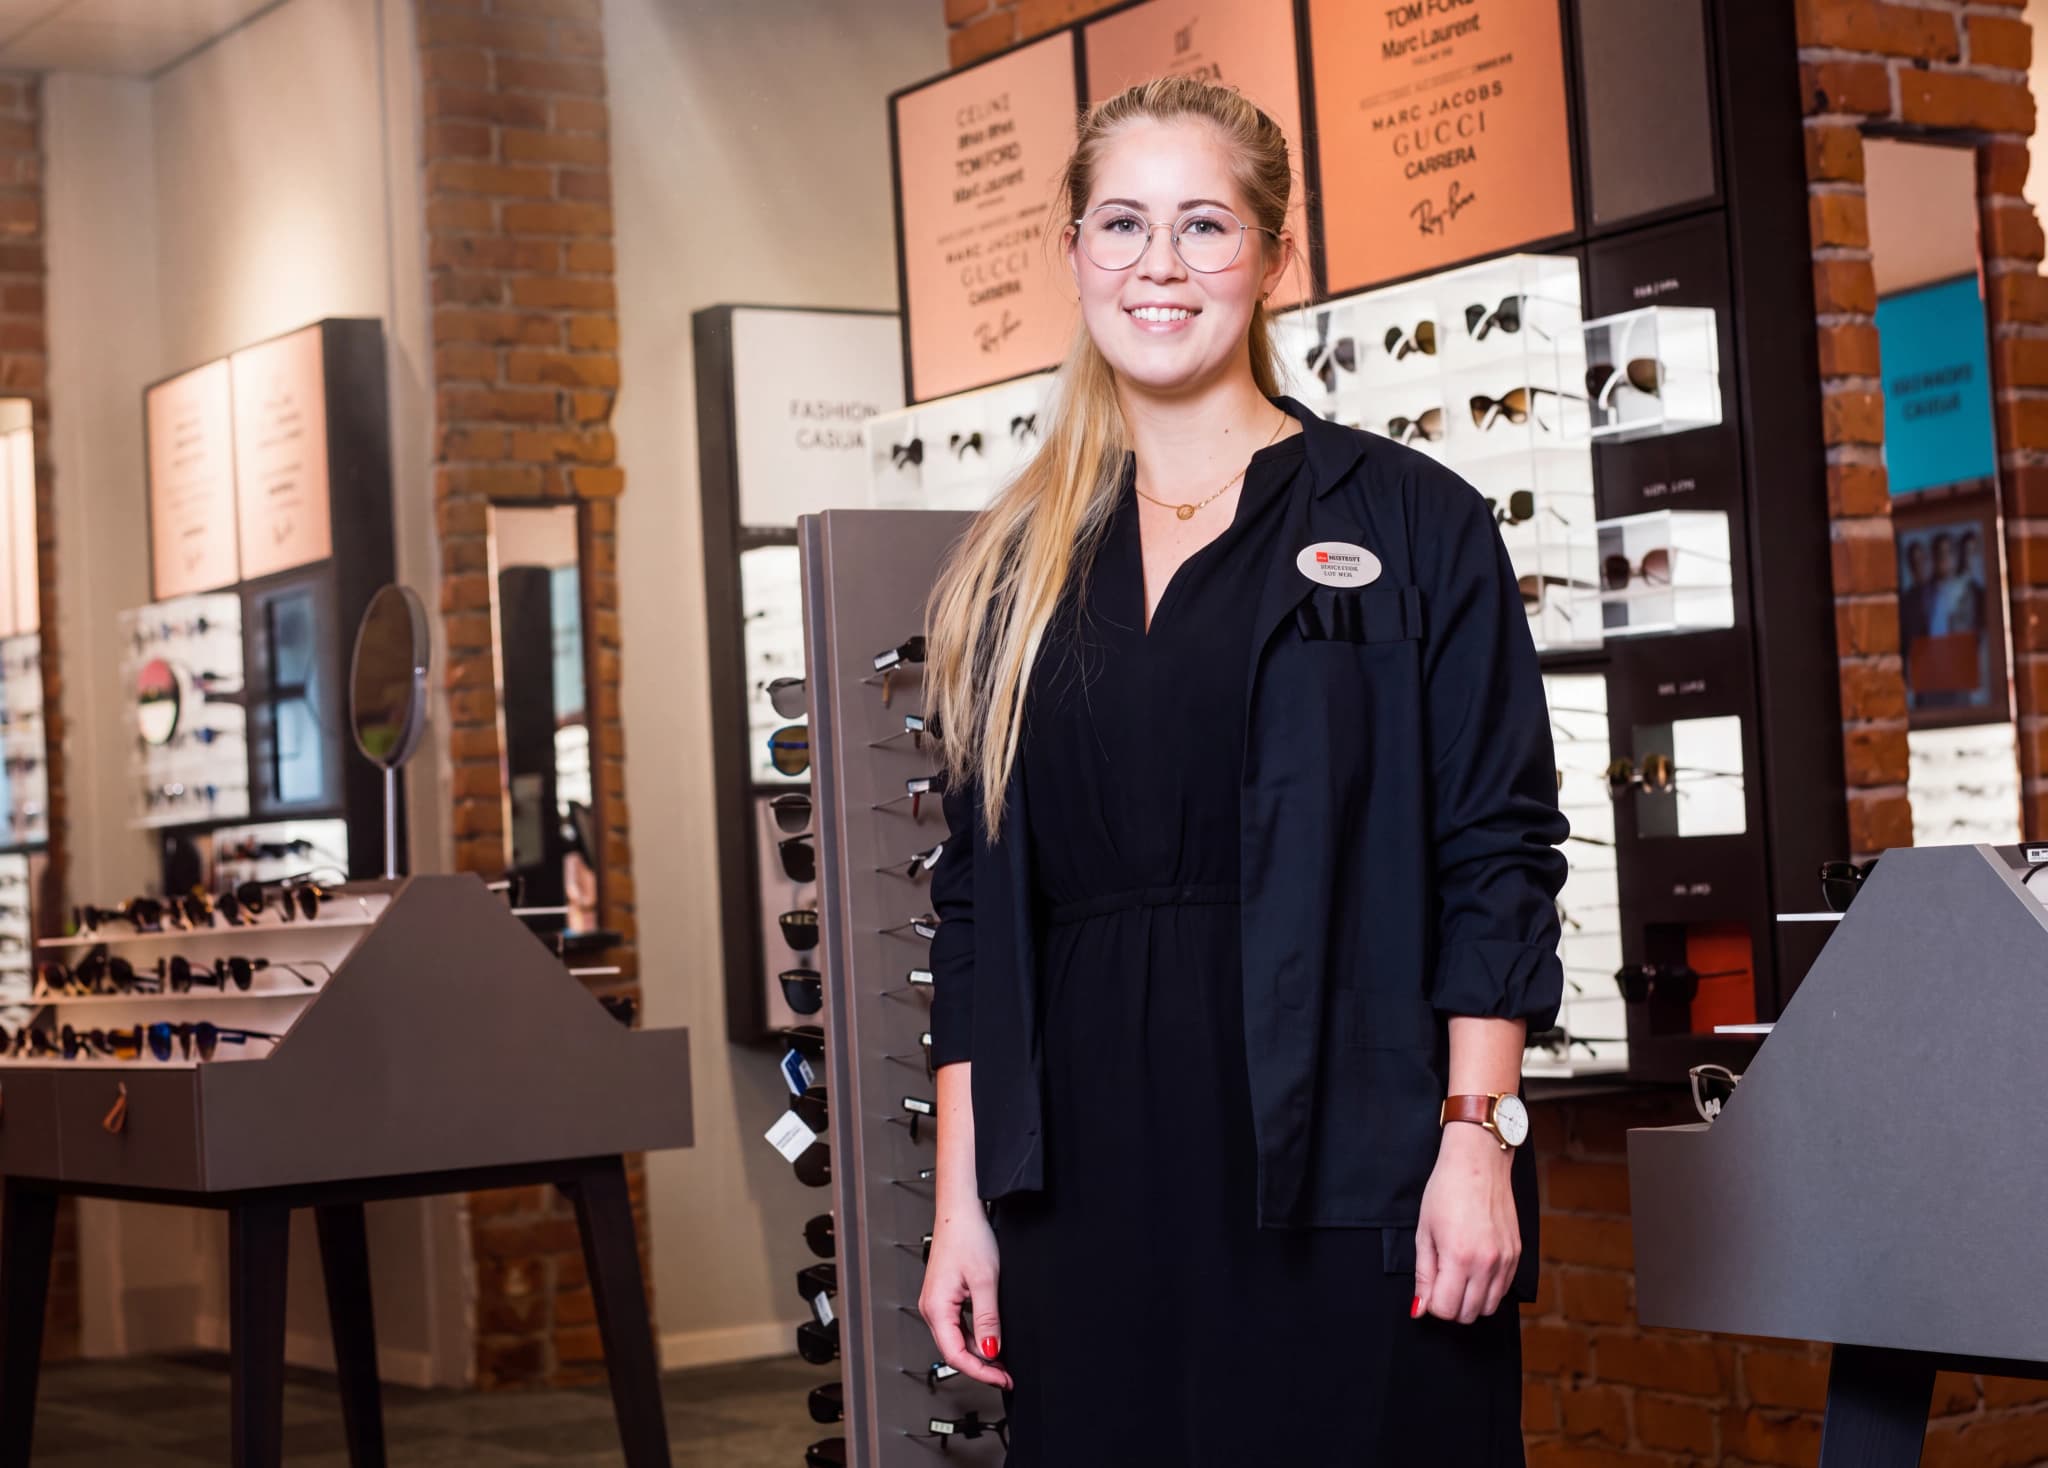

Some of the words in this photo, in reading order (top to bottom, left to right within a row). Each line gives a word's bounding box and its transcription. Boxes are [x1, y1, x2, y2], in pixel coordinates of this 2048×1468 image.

[1382, 36, 1417, 58] Marc
[1421, 13, 1479, 48] Laurent
[1384, 1, 1422, 31] TOM
[1427, 0, 1475, 16] FO
[1372, 105, 1421, 132] MARC
[1429, 80, 1503, 116] JACOBS
[1393, 110, 1486, 157] GUCCI
[1404, 145, 1476, 180] CARRERA
[960, 250, 1029, 287] GUCCI
